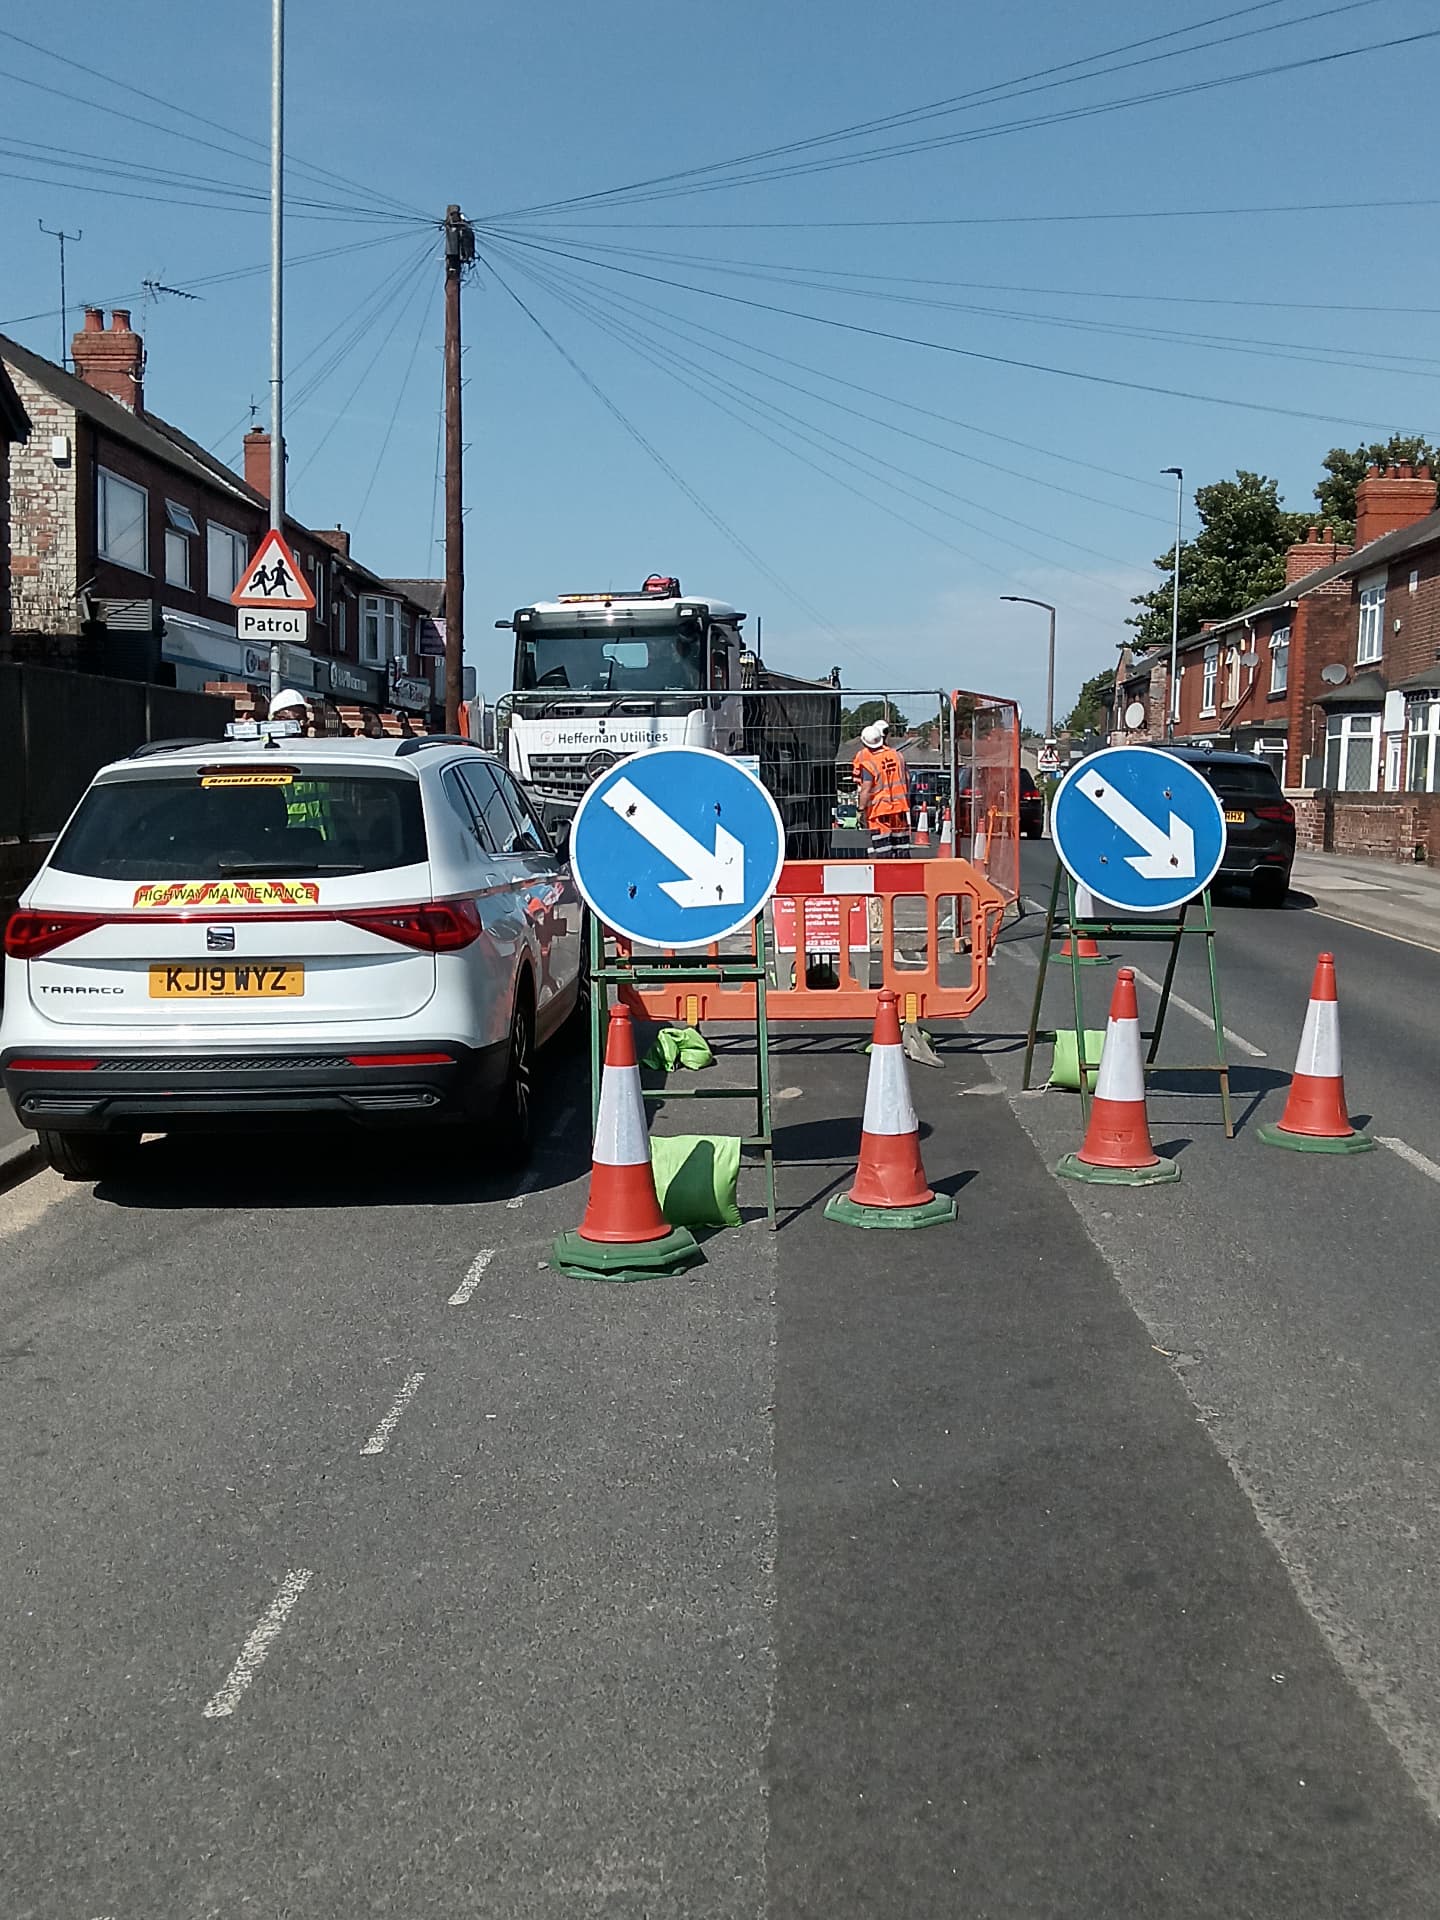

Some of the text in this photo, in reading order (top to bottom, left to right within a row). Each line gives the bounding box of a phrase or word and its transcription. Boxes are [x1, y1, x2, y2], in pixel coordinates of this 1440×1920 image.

[244, 616, 300, 633] Patrol
[558, 730, 669, 744] Heffernan Utilities
[138, 886, 316, 902] HIGHWAY MAINTENANCE
[166, 966, 287, 992] KJ19 WYZ
[40, 985, 124, 995] TARRACO
